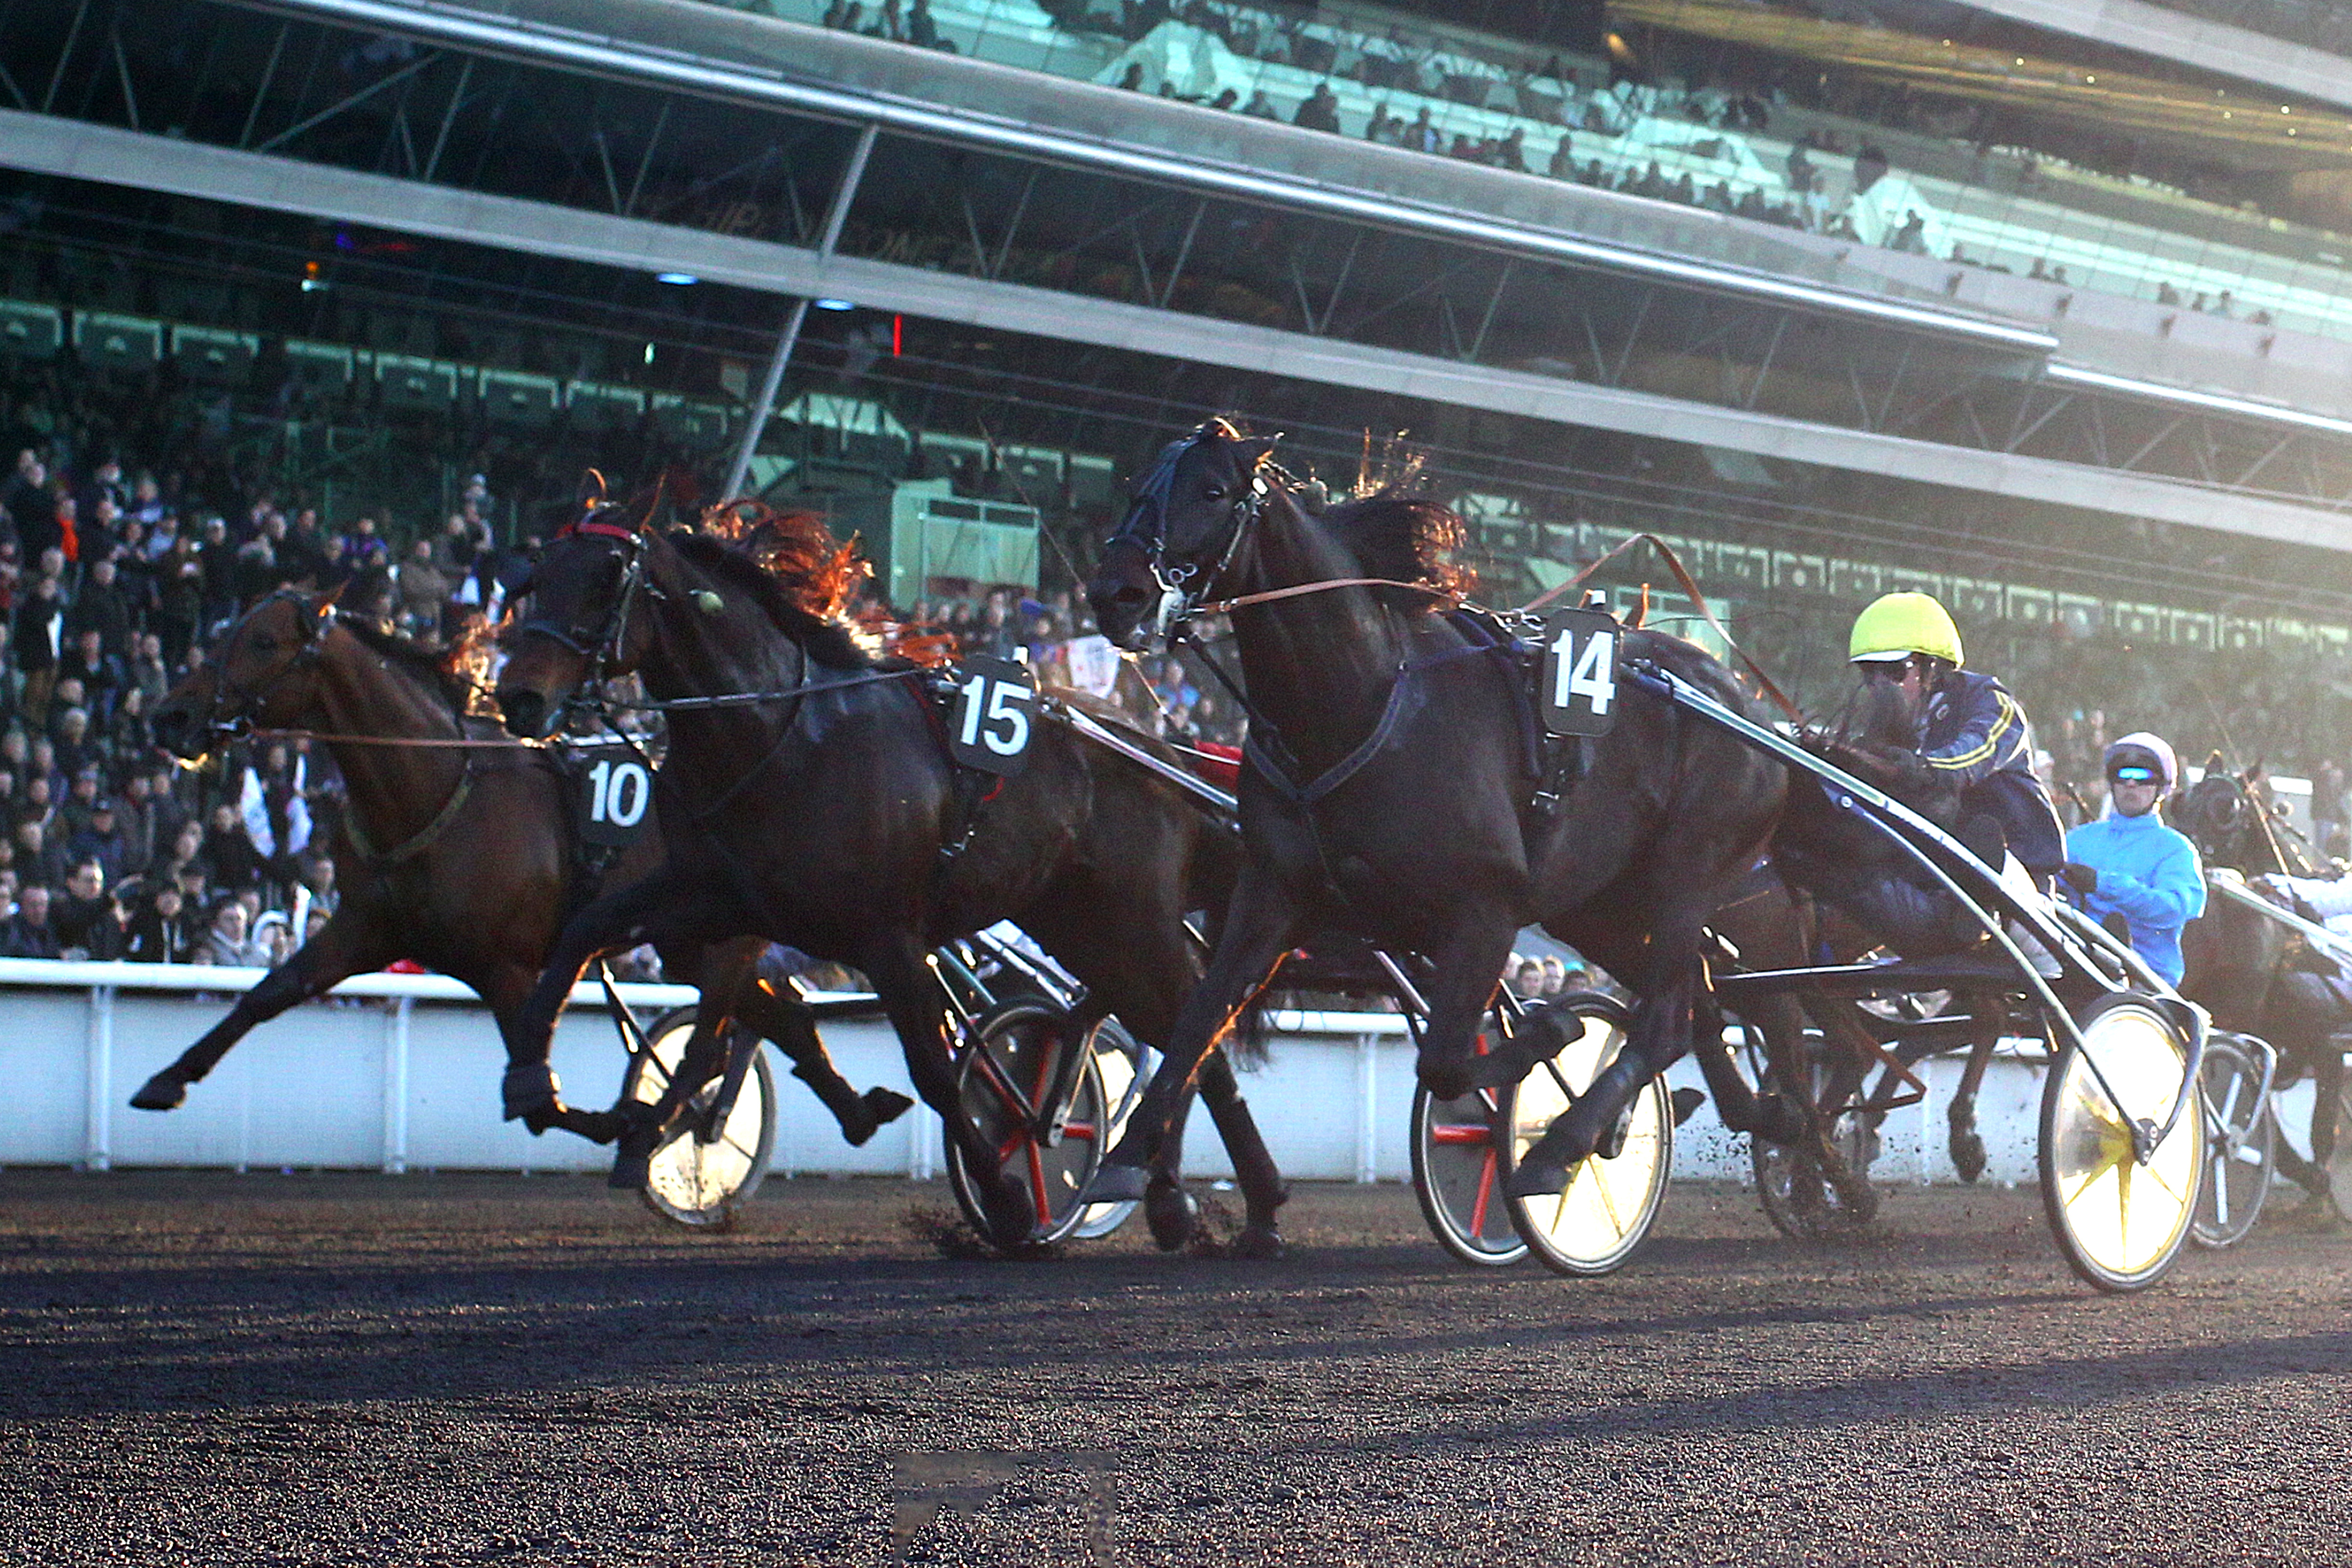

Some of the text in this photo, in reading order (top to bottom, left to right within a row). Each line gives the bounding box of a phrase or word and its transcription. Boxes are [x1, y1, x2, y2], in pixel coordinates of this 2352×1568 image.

[1551, 629, 1616, 715] 14
[960, 675, 1031, 756] 15
[589, 760, 649, 827] 10
